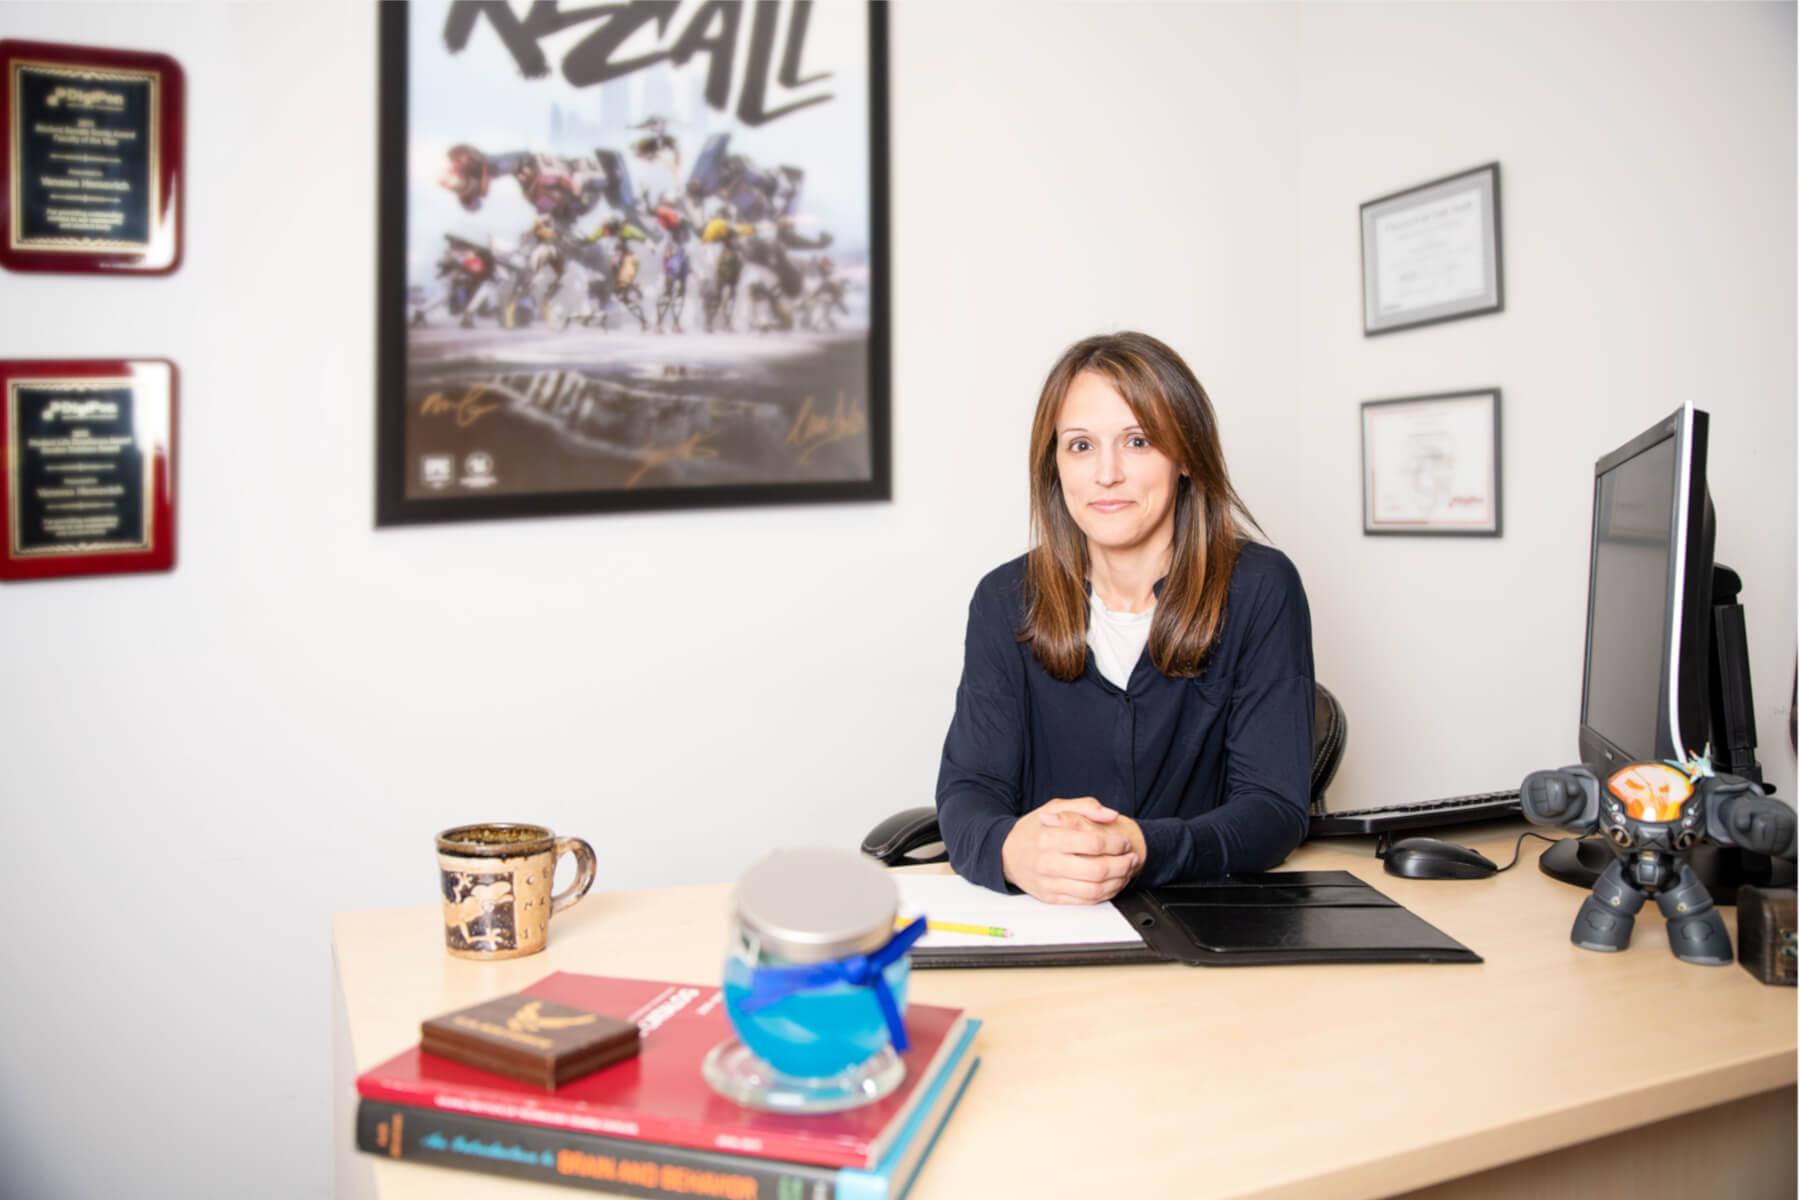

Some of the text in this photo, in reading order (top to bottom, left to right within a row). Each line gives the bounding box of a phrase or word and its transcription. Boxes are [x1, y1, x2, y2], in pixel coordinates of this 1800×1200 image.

[556, 1147, 618, 1182] BRAIN
[616, 1158, 661, 1190] AND
[659, 1163, 759, 1200] BEHAVIOR
